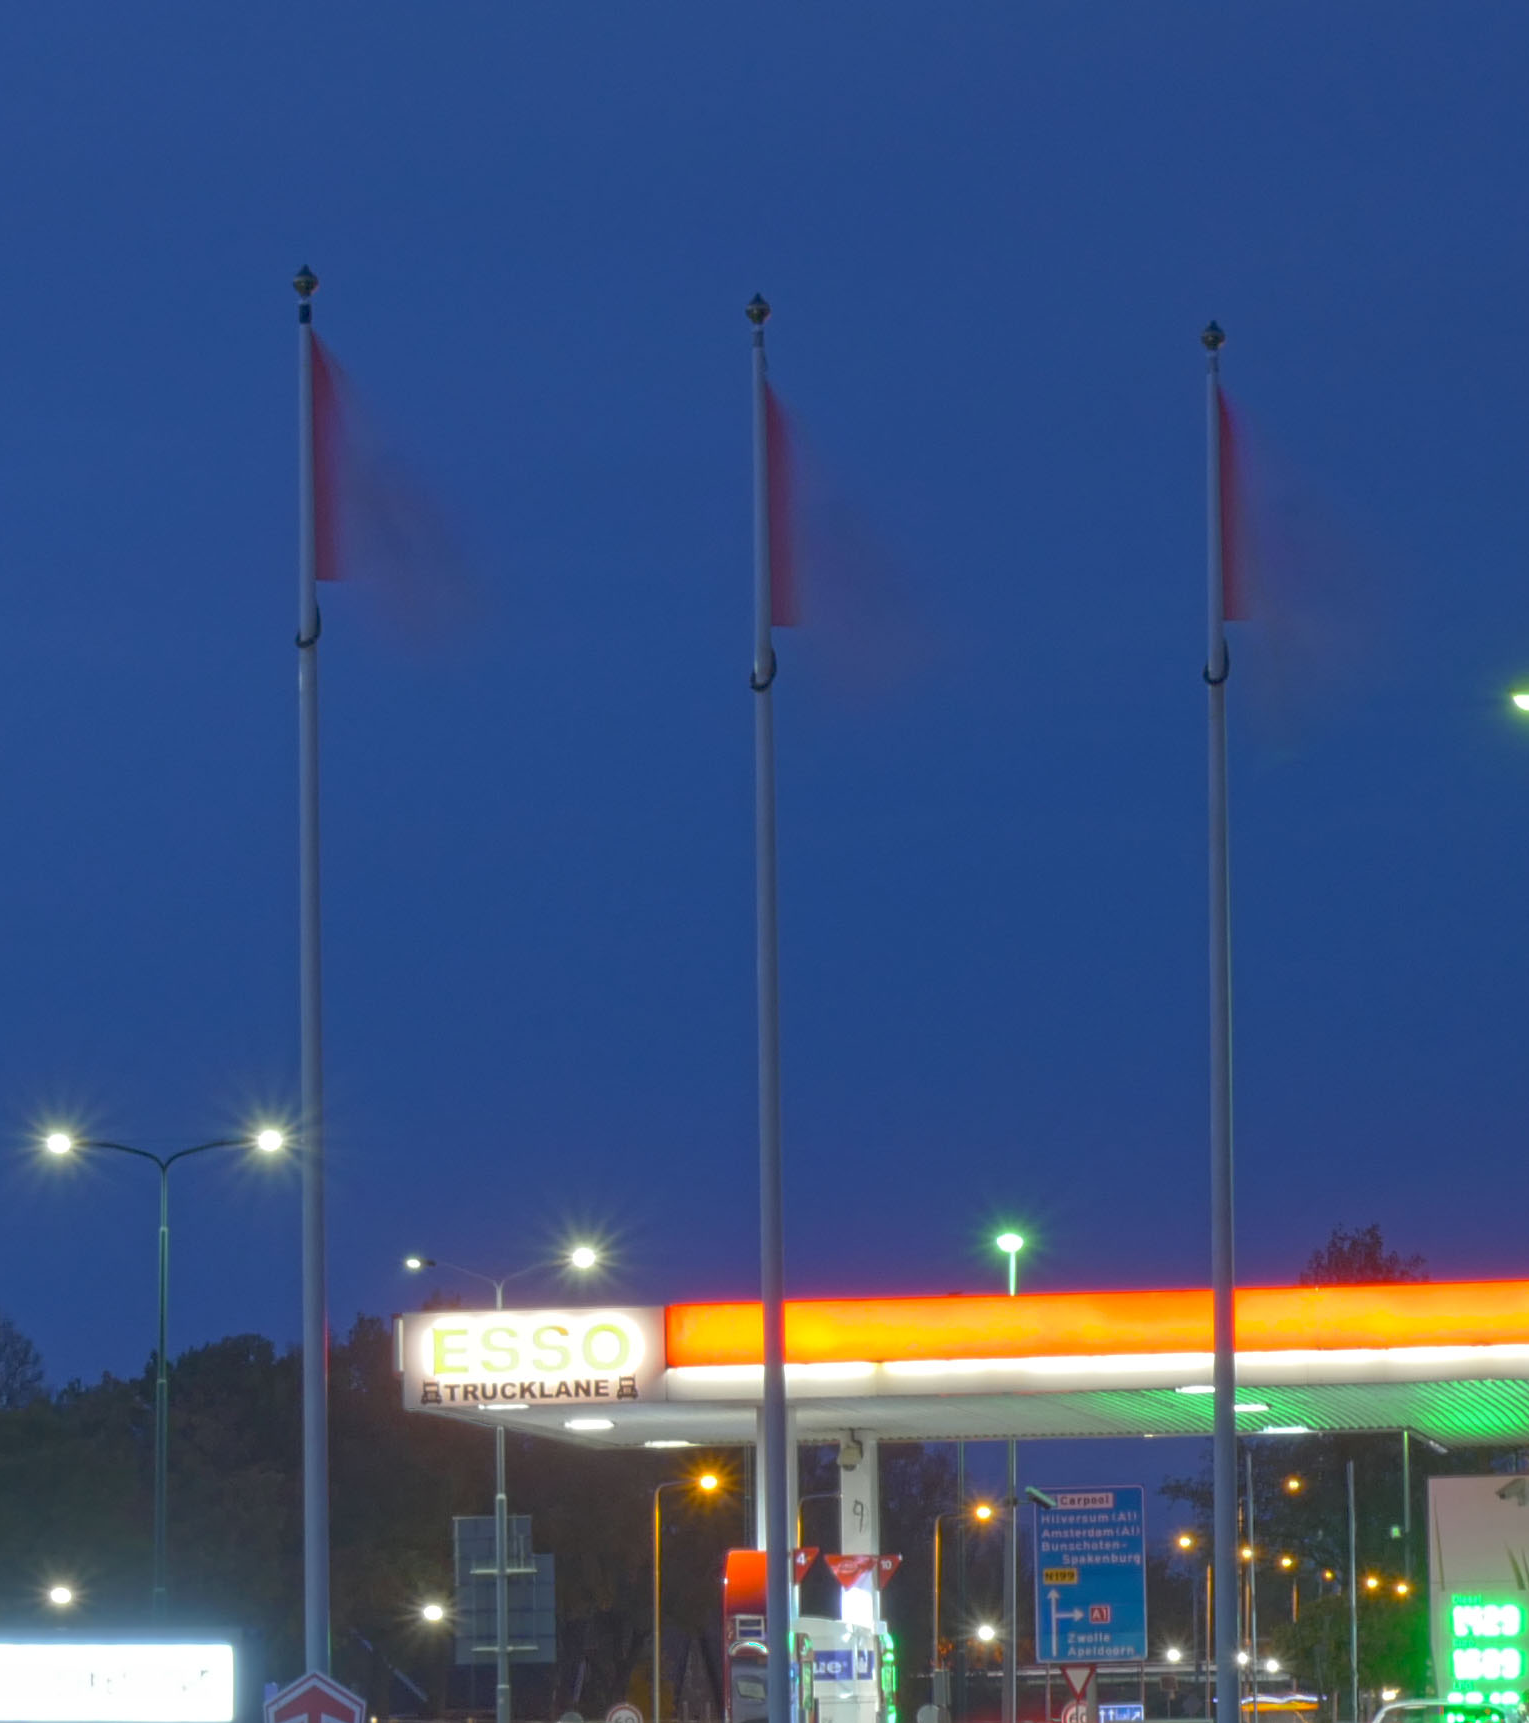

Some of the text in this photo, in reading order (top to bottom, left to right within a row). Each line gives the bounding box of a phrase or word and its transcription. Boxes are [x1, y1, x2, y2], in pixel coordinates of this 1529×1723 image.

[432, 1323, 631, 1376] ESSO
[444, 1379, 610, 1401] TRUCKLANE
[1060, 1494, 1110, 1506] Carpool
[1042, 1513, 1109, 1524] Hilversum
[1042, 1527, 1114, 1538] Amsterdam
[797, 1552, 806, 1565] 4
[1063, 1552, 1141, 1565] Spakenburg
[881, 1560, 892, 1570] 10
[1092, 1608, 1107, 1620] A1
[1067, 1632, 1111, 1643] Zwolle
[1067, 1646, 1134, 1657] Apeldoorn
